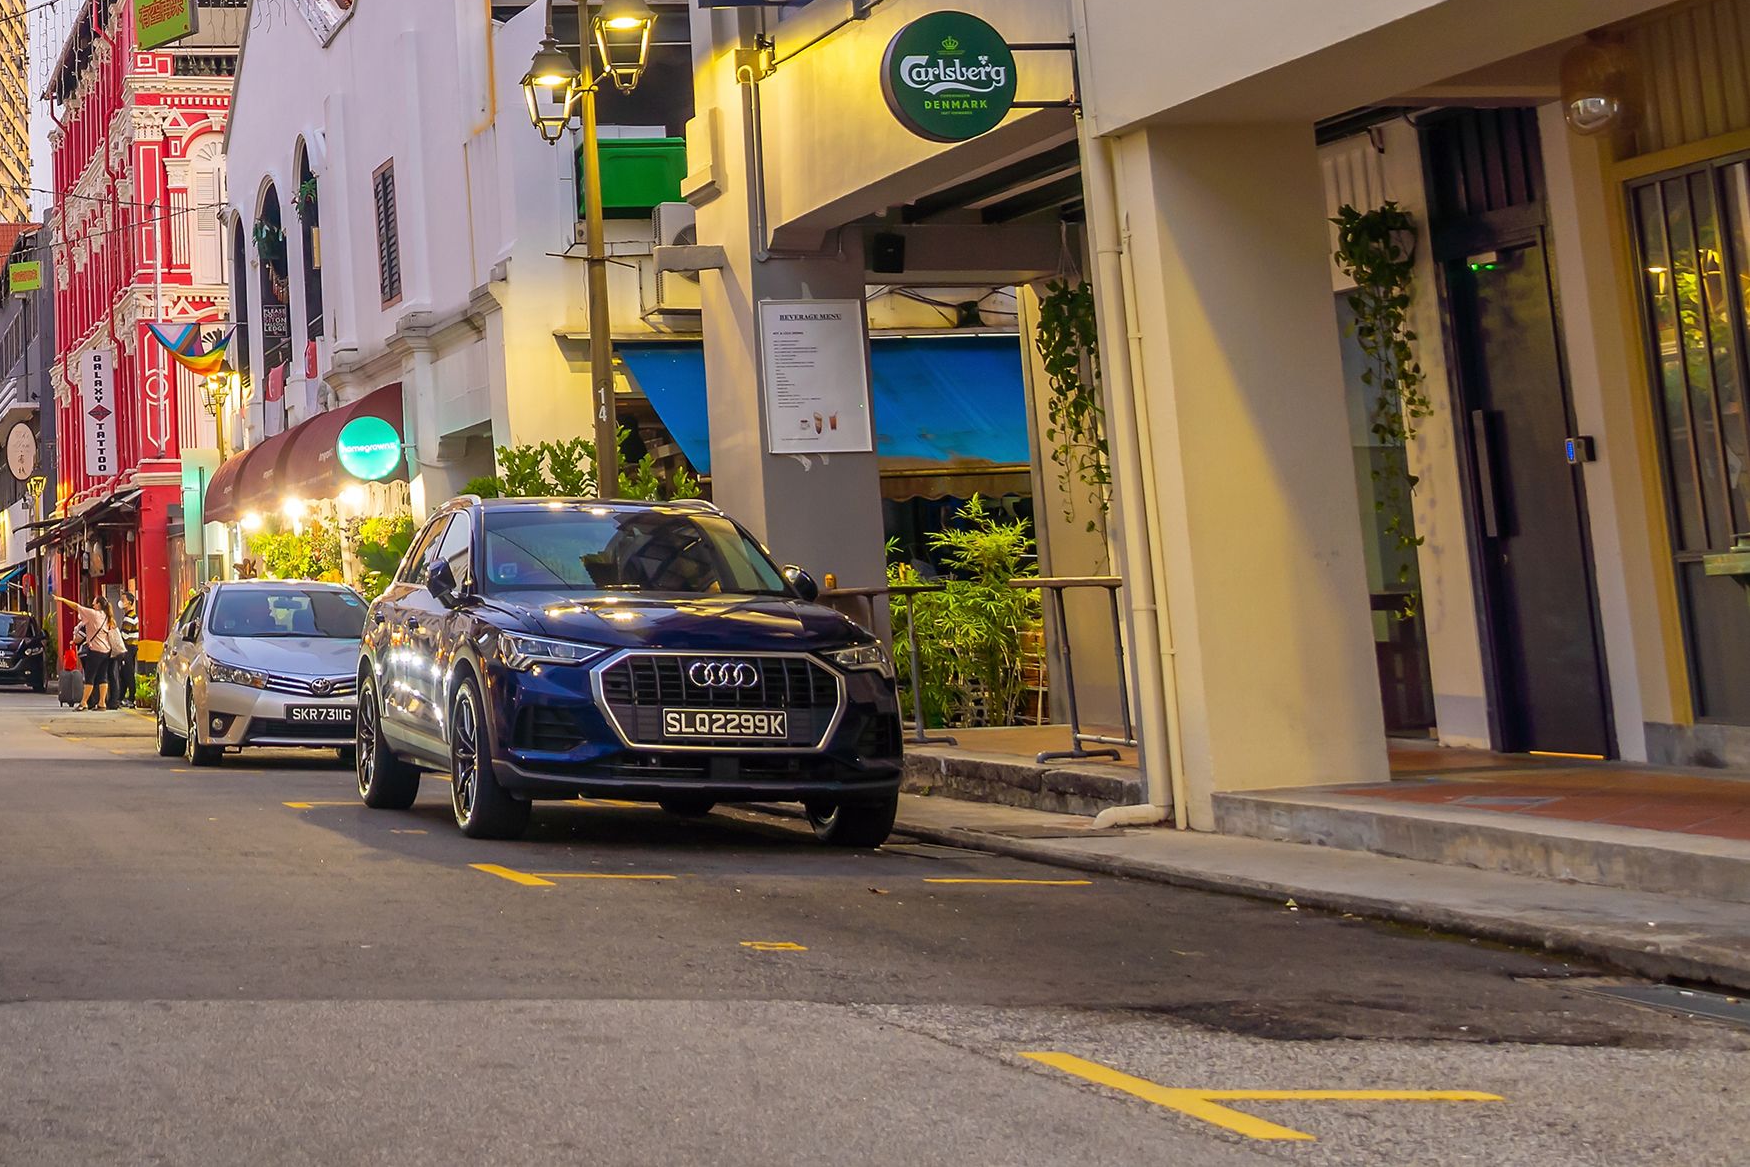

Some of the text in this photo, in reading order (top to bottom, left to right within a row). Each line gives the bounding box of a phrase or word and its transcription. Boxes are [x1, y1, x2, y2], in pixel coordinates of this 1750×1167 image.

[900, 55, 1006, 92] Carlsberg
[924, 100, 988, 109] DENMARK
[93, 355, 107, 471] GALAXY TATTOO
[342, 442, 390, 453] homegrown
[666, 713, 785, 735] SLQ2299K
